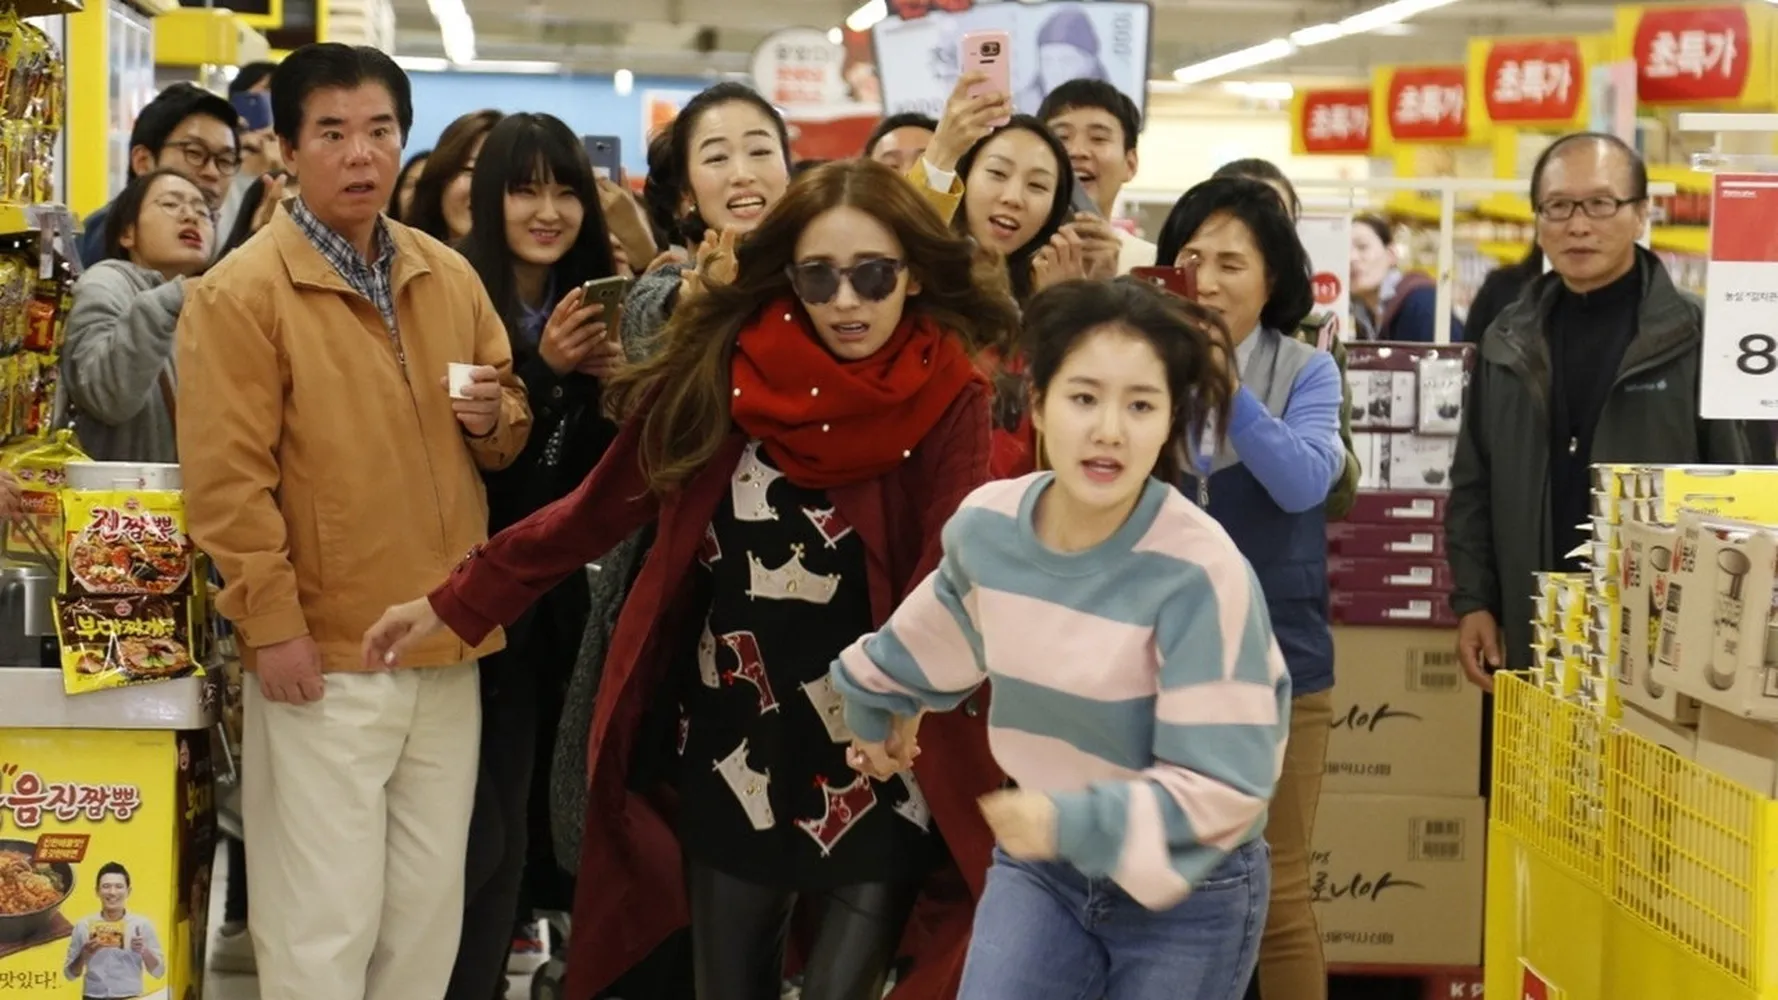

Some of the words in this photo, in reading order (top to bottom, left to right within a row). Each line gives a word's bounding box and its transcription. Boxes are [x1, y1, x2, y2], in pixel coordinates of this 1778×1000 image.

[1645, 29, 1738, 78] 초특가
[1493, 59, 1572, 104] 초특가
[1307, 103, 1369, 140] 초특가
[1394, 83, 1464, 125] 초특가
[90, 506, 178, 542] 진짬뽕
[0, 771, 141, 827] 음진짬뽕
[0, 970, 57, 990] 맛있다!
